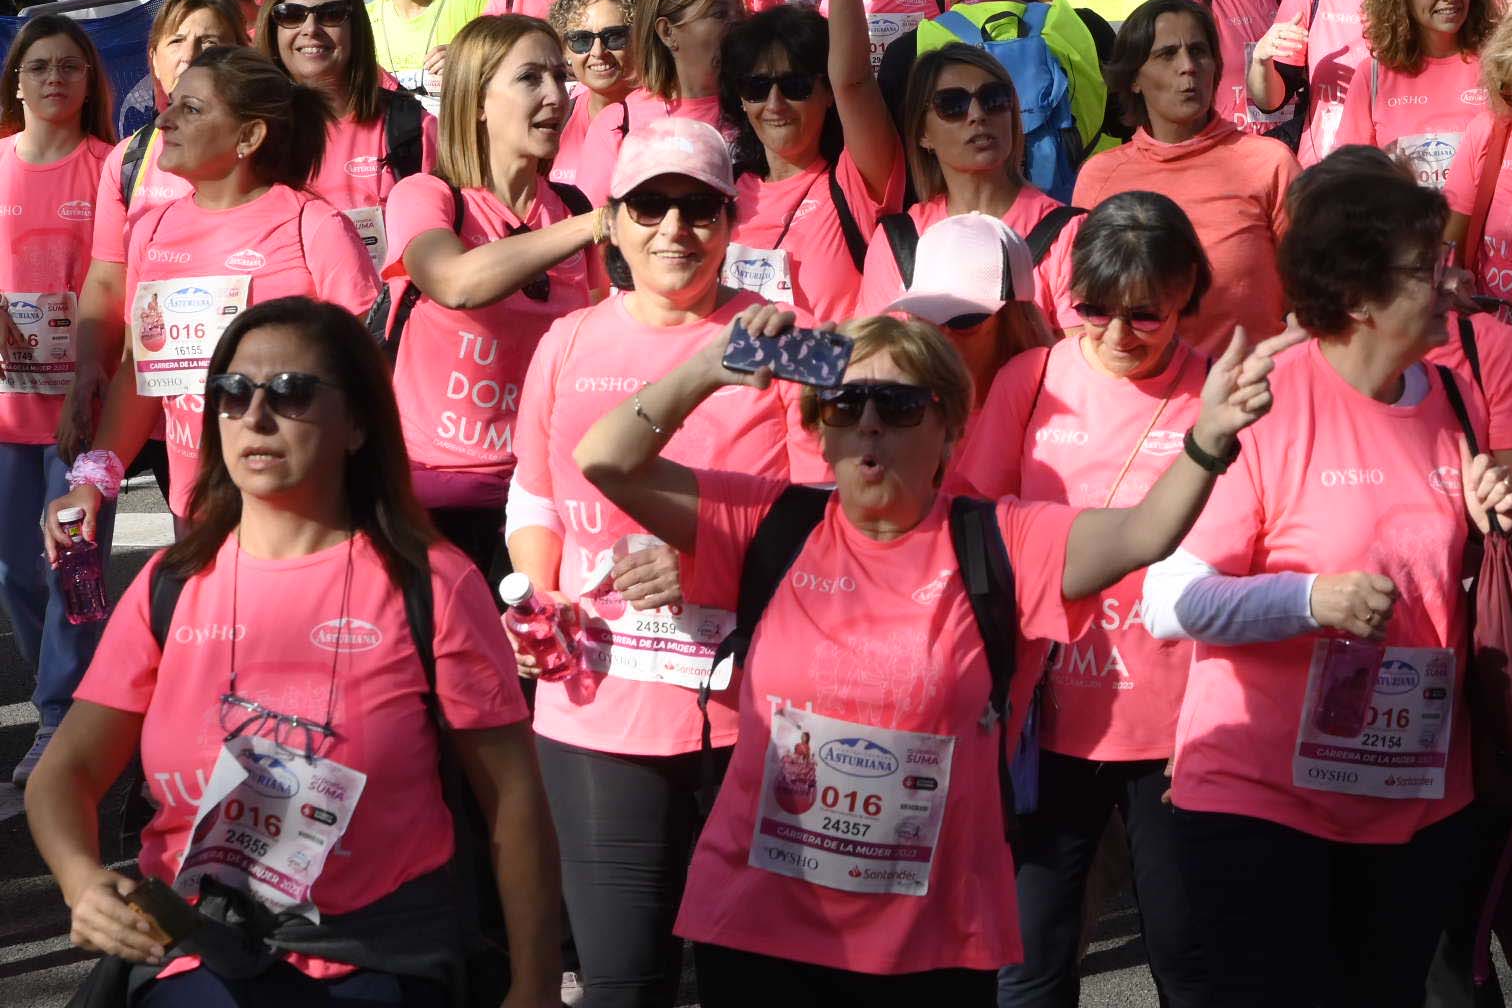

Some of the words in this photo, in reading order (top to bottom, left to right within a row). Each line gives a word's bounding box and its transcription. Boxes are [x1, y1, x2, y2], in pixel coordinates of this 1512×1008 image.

[1387, 95, 1428, 108] OYSHO
[147, 248, 191, 263] OYSHO
[169, 323, 206, 340] 016
[174, 345, 203, 357] 16155
[457, 331, 498, 366] TU
[149, 360, 179, 371] CARRERA
[179, 359, 189, 369] DE
[190, 359, 198, 368] LA
[447, 370, 518, 411] DOR
[575, 376, 639, 393] OYSHO
[437, 410, 513, 453] SUM
[1321, 468, 1384, 488] OYSHO
[565, 499, 603, 534] TU
[635, 619, 678, 635] 24359
[601, 632, 637, 648] CARRERA
[638, 639, 653, 649] DE
[653, 640, 667, 650] LA
[667, 642, 697, 653] MUJER
[1361, 734, 1402, 748] 22154
[824, 746, 893, 772] ASTURIANA
[905, 753, 939, 765] SUMA
[1316, 748, 1362, 760] CARRERA
[1363, 753, 1376, 761] DE
[1377, 754, 1390, 763] LA
[1308, 767, 1359, 783] OYSHO
[153, 768, 207, 806] TU
[821, 785, 883, 817] 016
[223, 798, 282, 838] 016
[822, 816, 871, 838] 24357
[776, 826, 821, 846] CARRERA
[824, 839, 839, 850] DE
[840, 842, 854, 853] LA
[855, 844, 893, 857] MUJER
[769, 846, 819, 871] OYSHO
[863, 868, 917, 882] Santander
